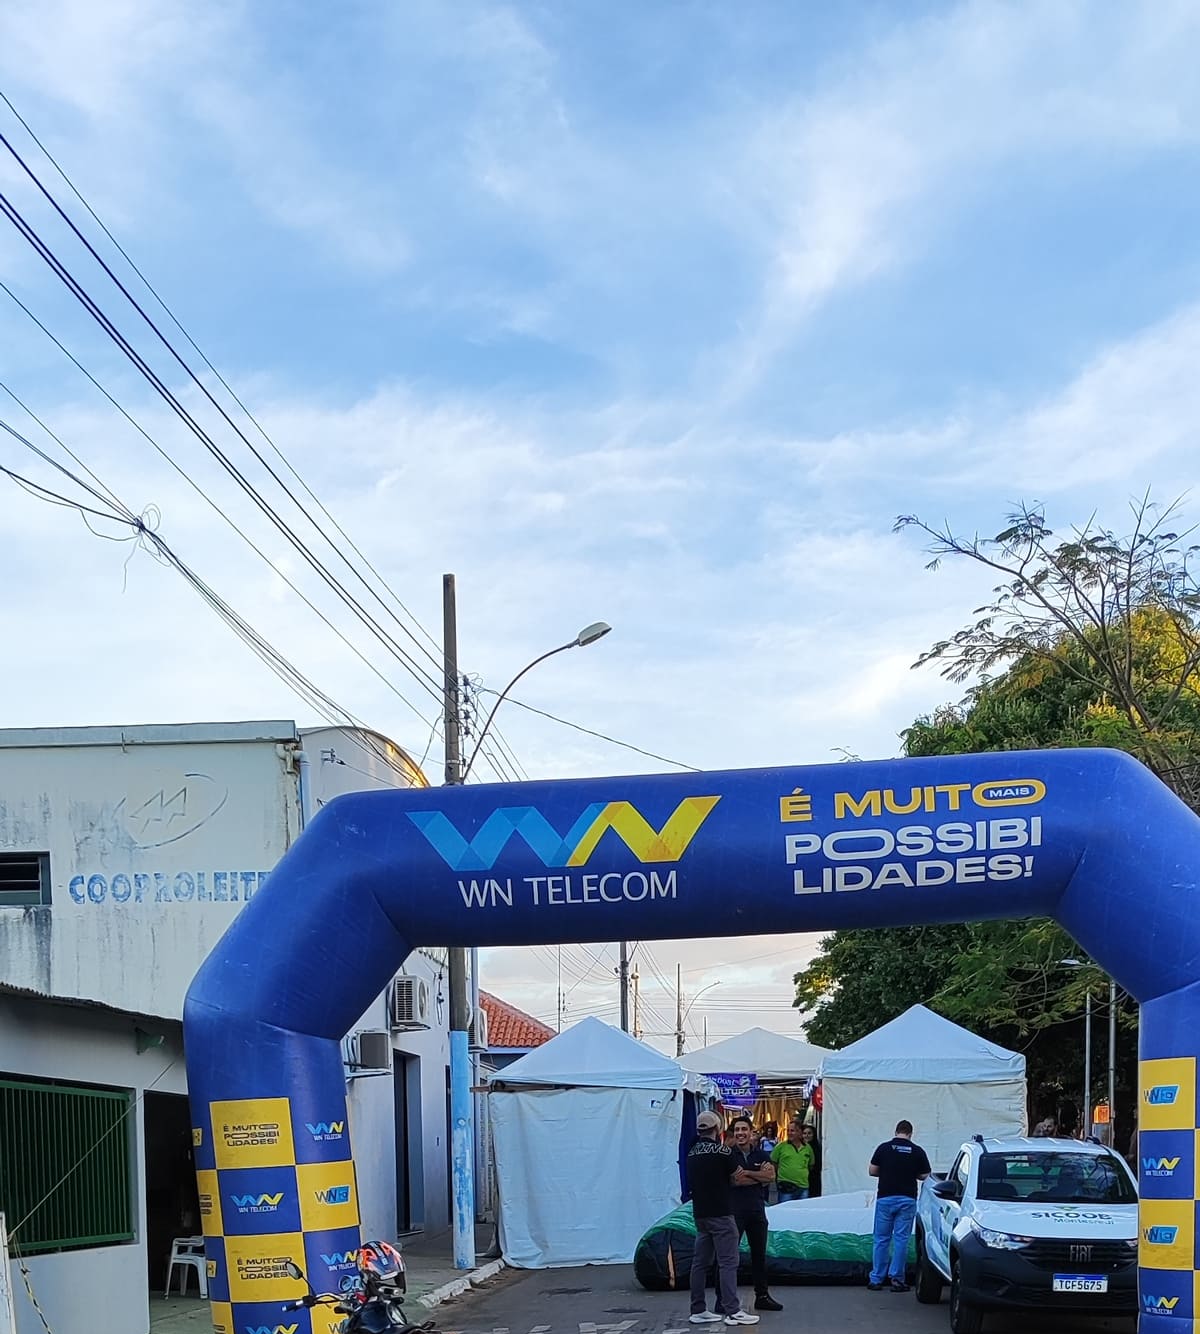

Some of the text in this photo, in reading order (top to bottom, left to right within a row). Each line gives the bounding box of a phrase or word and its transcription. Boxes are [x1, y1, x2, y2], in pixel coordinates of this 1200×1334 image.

[779, 778, 1047, 823] É MUITO MAIS
[784, 815, 1042, 864] POSSIBI
[457, 870, 678, 908] WN TELECOM
[793, 854, 1034, 895] LIDADES!
[1069, 1244, 1095, 1263] FIAT
[1059, 1280, 1102, 1290] TCF5G75
